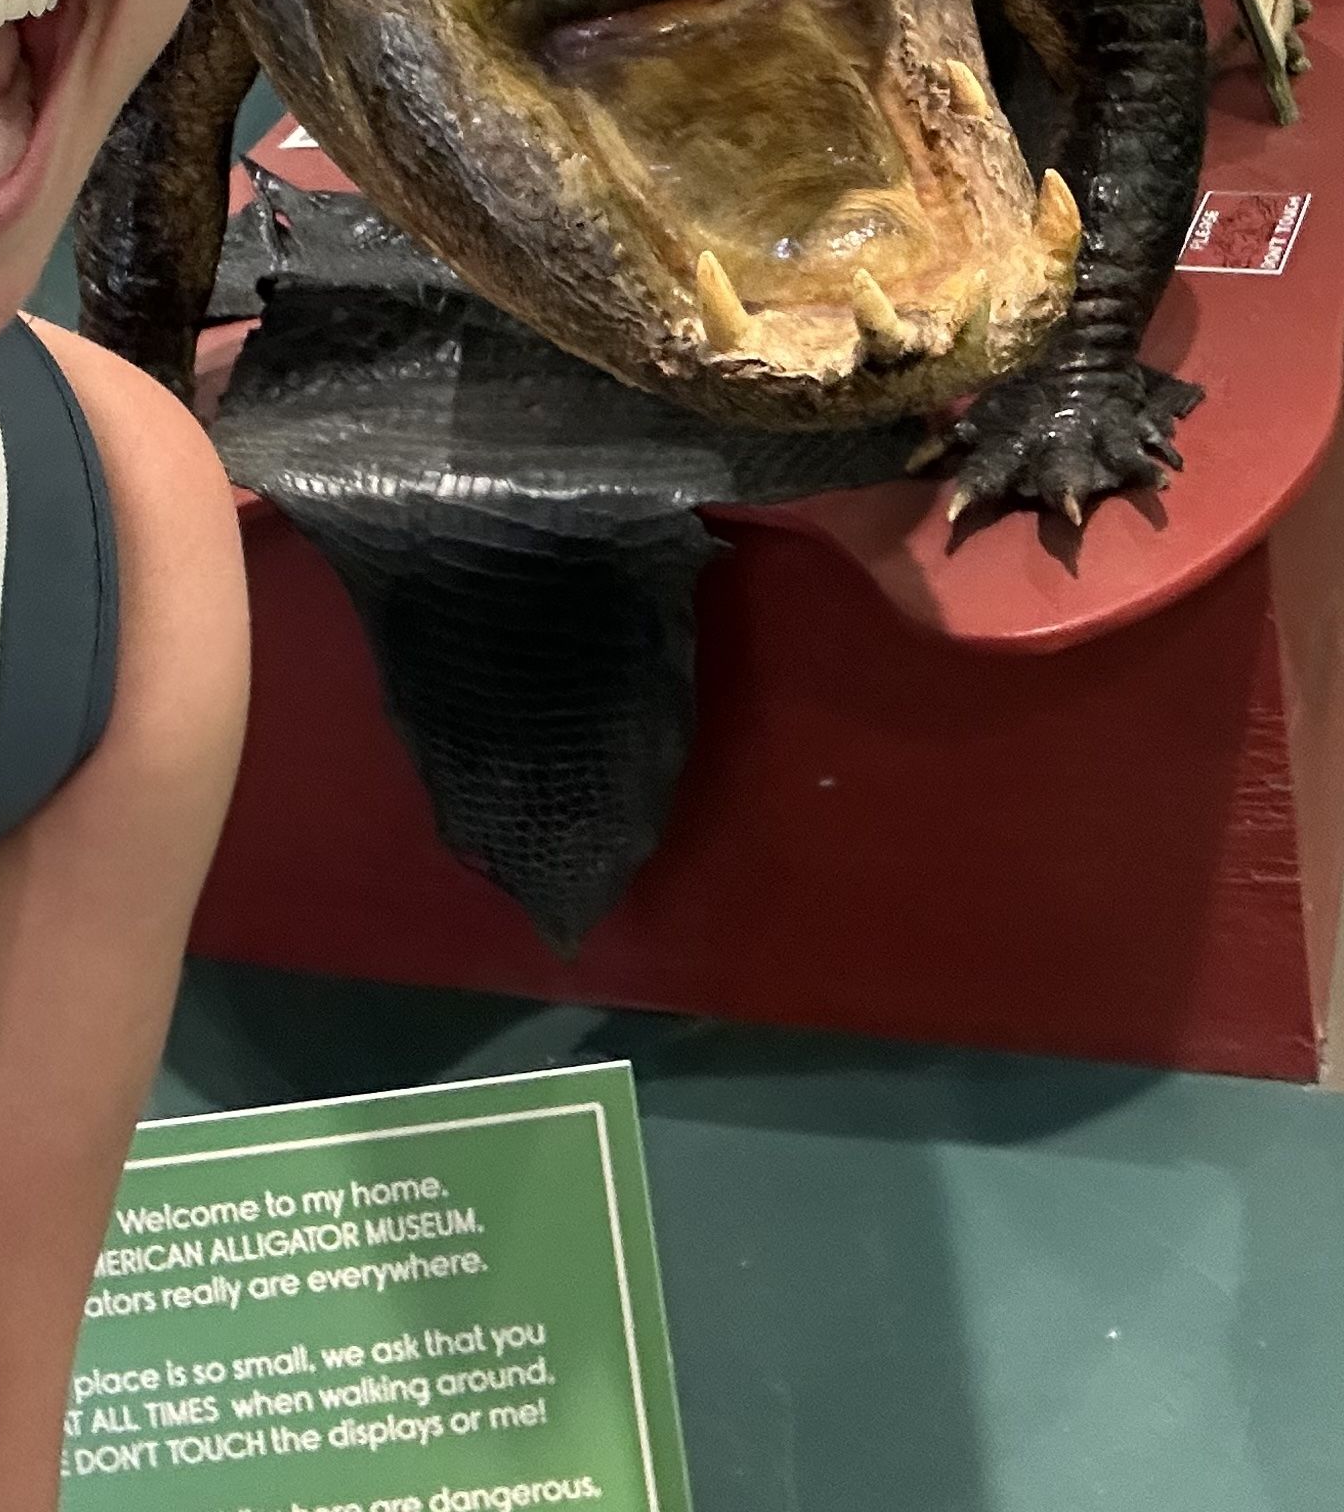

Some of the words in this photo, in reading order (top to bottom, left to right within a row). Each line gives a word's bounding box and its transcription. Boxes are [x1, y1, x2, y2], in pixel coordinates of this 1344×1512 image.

[1189, 210, 1220, 251] PLEASE
[116, 1199, 261, 1235] Welcome
[264, 1189, 297, 1219] to
[301, 1188, 345, 1219] my
[350, 1176, 450, 1208] home.
[209, 1220, 361, 1266] ALLIGATOR
[364, 1207, 486, 1247] MUSEUM.
[160, 1274, 242, 1311] really
[247, 1273, 301, 1301] are
[306, 1251, 489, 1293] everywhere.
[73, 1367, 161, 1405] place
[165, 1359, 188, 1388] is
[192, 1360, 226, 1386] so
[320, 1344, 365, 1369] we
[371, 1332, 421, 1364] ask
[424, 1324, 488, 1358] that
[490, 1322, 547, 1358] you
[90, 1404, 142, 1435] ALL
[143, 1394, 221, 1430] TIMES
[230, 1388, 315, 1420] when
[317, 1374, 432, 1410] walking
[435, 1355, 556, 1397] around.
[74, 1439, 159, 1476] DON'T
[164, 1429, 268, 1466] TOUCH
[270, 1425, 323, 1455] the
[327, 1413, 445, 1453] displays
[449, 1409, 482, 1435] or
[488, 1396, 548, 1430] me!
[428, 1476, 603, 1512] dangerous.
